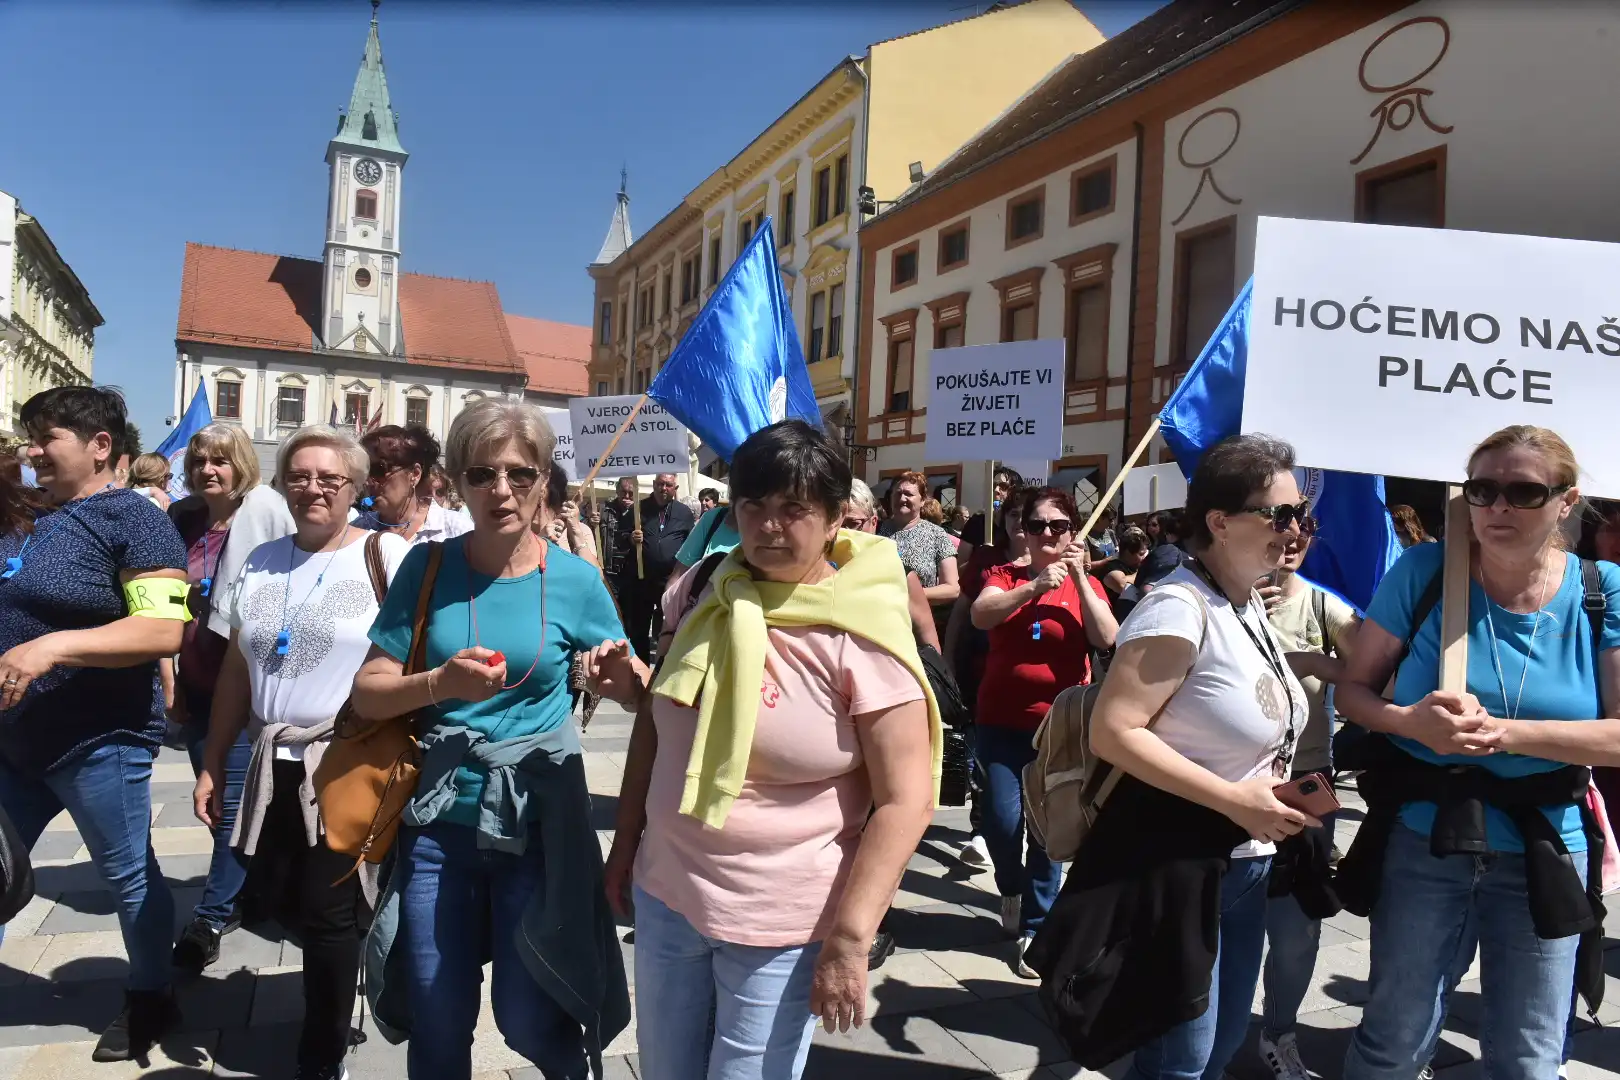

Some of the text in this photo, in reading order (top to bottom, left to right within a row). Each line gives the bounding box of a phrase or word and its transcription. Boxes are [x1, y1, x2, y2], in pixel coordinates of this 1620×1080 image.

[1274, 296, 1620, 357] HOĆEMO NAŠ
[936, 368, 1052, 390] POKUŠAJTE VI
[1378, 355, 1553, 405] PLAĆE
[961, 393, 1020, 411] ŽIVJETI
[580, 422, 617, 435] AJMO
[640, 420, 677, 432] STOL.
[946, 417, 1036, 437] BEZ PLAĆE
[588, 453, 676, 468] MOŽETE VI TO
